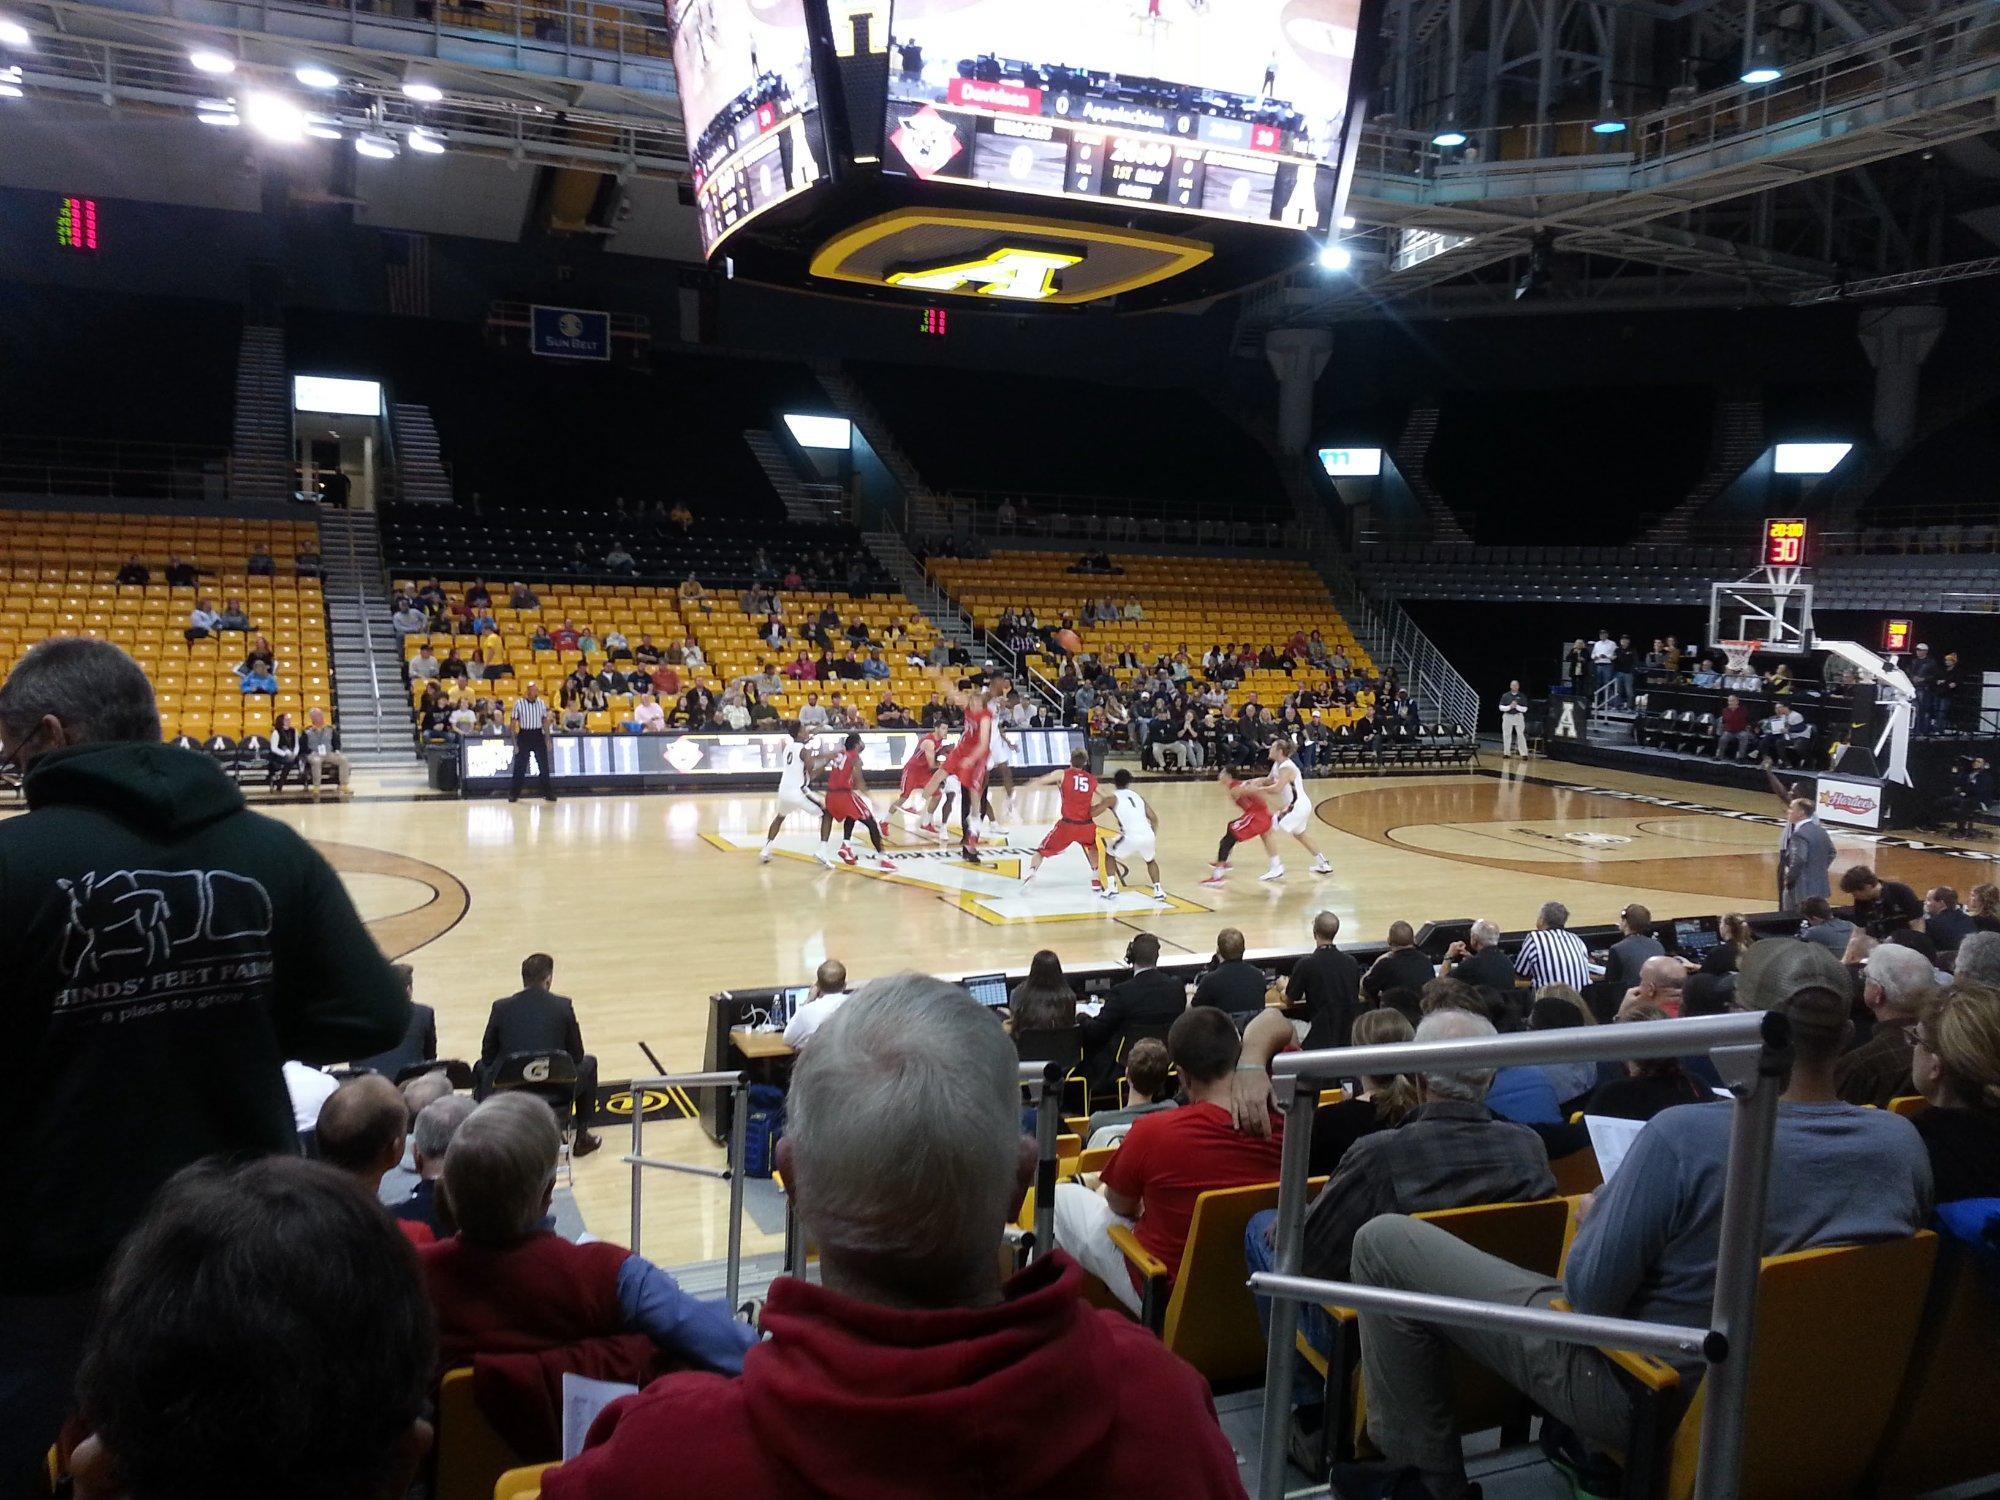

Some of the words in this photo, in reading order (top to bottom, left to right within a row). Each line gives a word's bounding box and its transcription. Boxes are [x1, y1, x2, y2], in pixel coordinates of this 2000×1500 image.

[1770, 523, 1804, 537] 20:00
[1772, 537, 1798, 562] 30
[1073, 775, 1089, 793] 15
[150, 966, 213, 991] FEET
